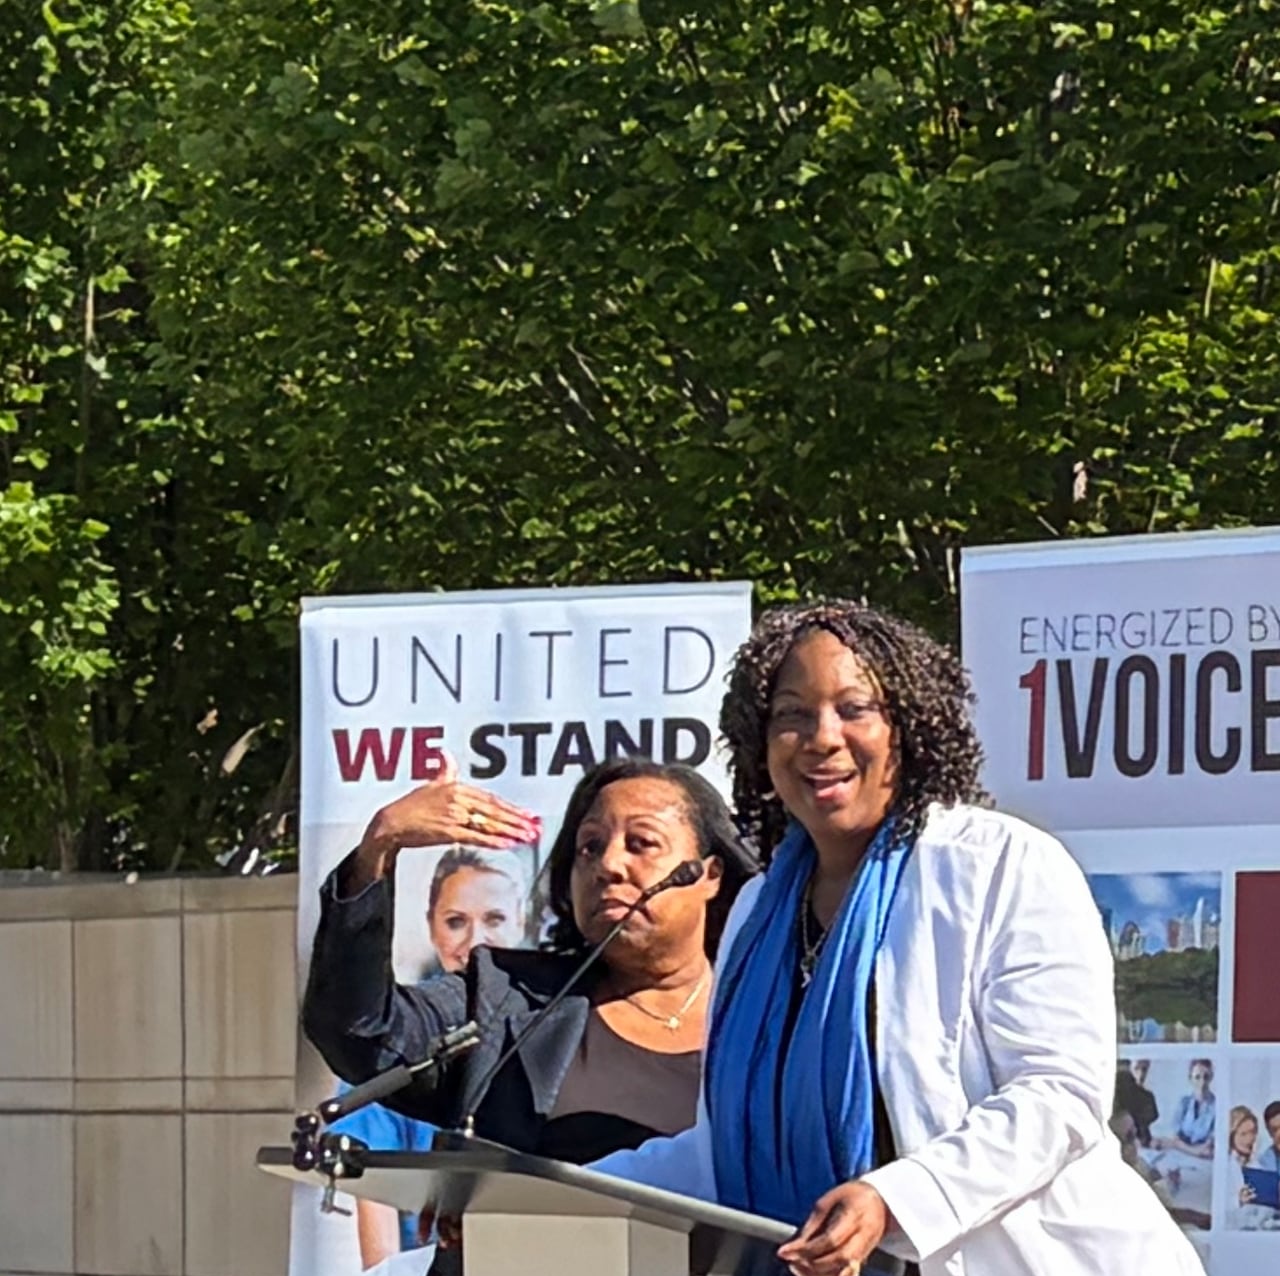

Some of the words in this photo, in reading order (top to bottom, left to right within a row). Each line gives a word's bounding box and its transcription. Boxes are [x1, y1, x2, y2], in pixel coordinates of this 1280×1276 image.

[1019, 607, 1234, 655] ENERGIZED
[331, 625, 717, 708] UNITED
[332, 725, 448, 783] WE
[468, 716, 712, 778] STAND
